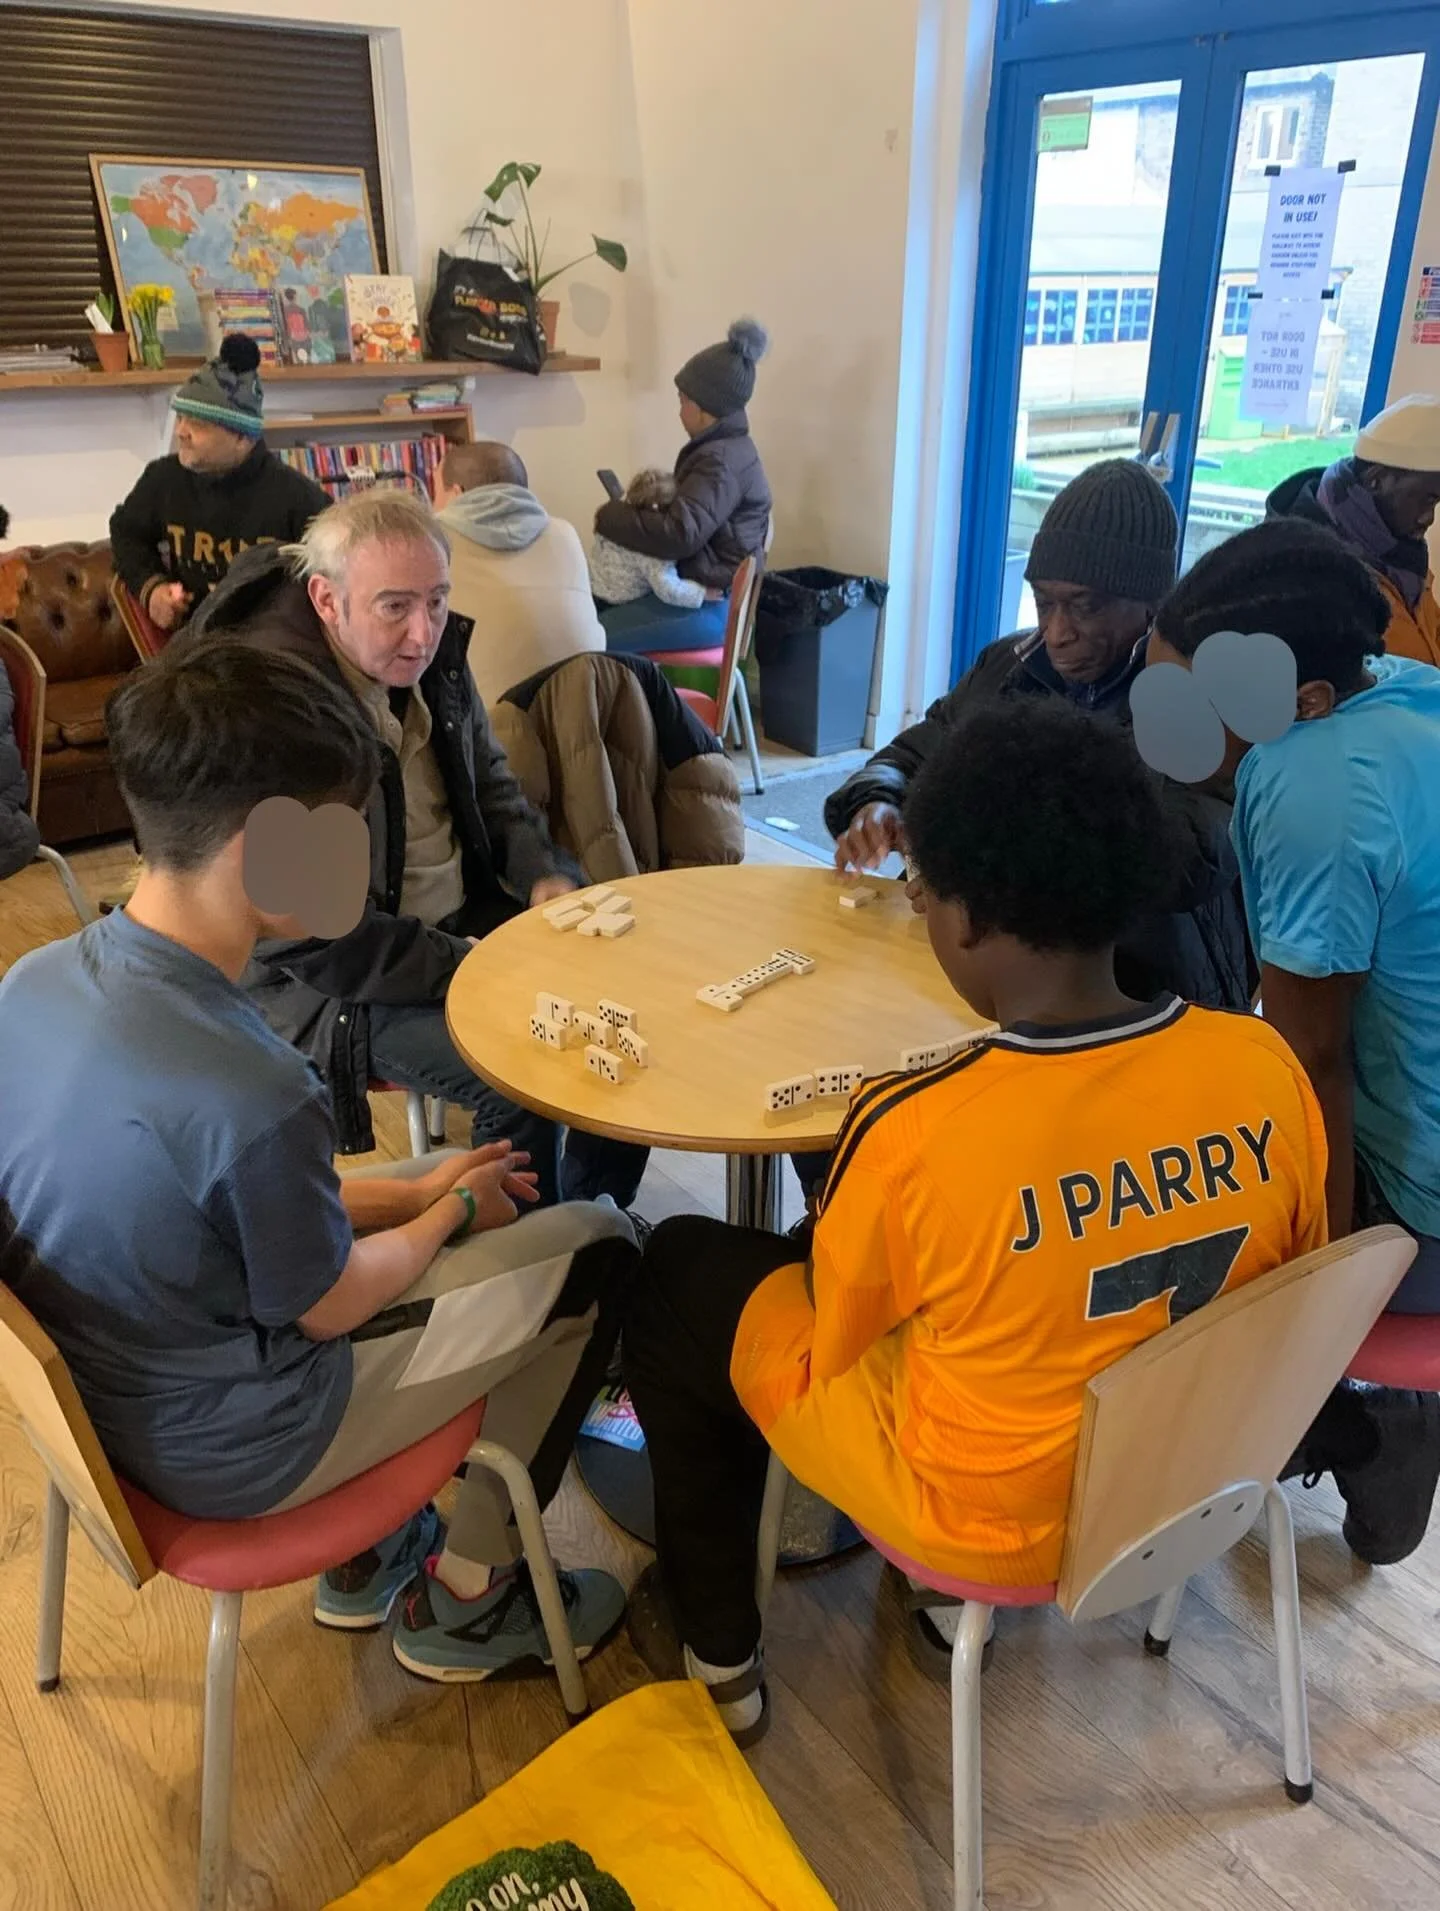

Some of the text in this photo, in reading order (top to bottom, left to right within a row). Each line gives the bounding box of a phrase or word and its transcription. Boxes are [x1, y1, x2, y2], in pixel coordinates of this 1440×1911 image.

[1280, 193, 1326, 206] DOOR NOT
[1283, 212, 1293, 223] IN
[1010, 1116, 1273, 1253] J PARRY
[1085, 1223, 1251, 1326] 7
